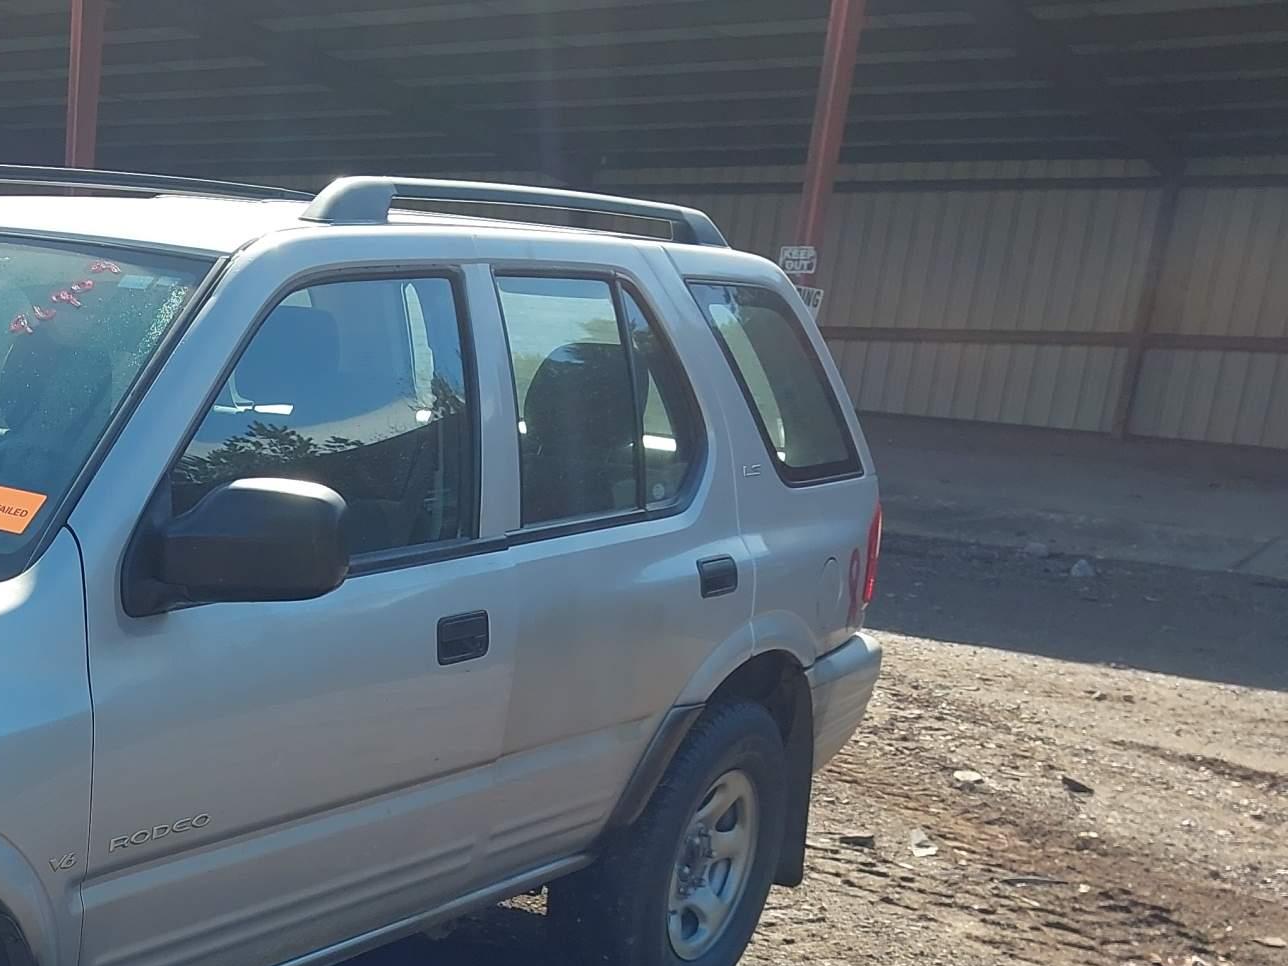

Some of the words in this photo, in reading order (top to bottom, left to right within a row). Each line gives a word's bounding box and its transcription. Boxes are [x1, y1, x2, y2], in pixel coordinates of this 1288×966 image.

[784, 260, 811, 271] OUT
[108, 812, 212, 854] RODEO
[48, 852, 78, 872] V6
